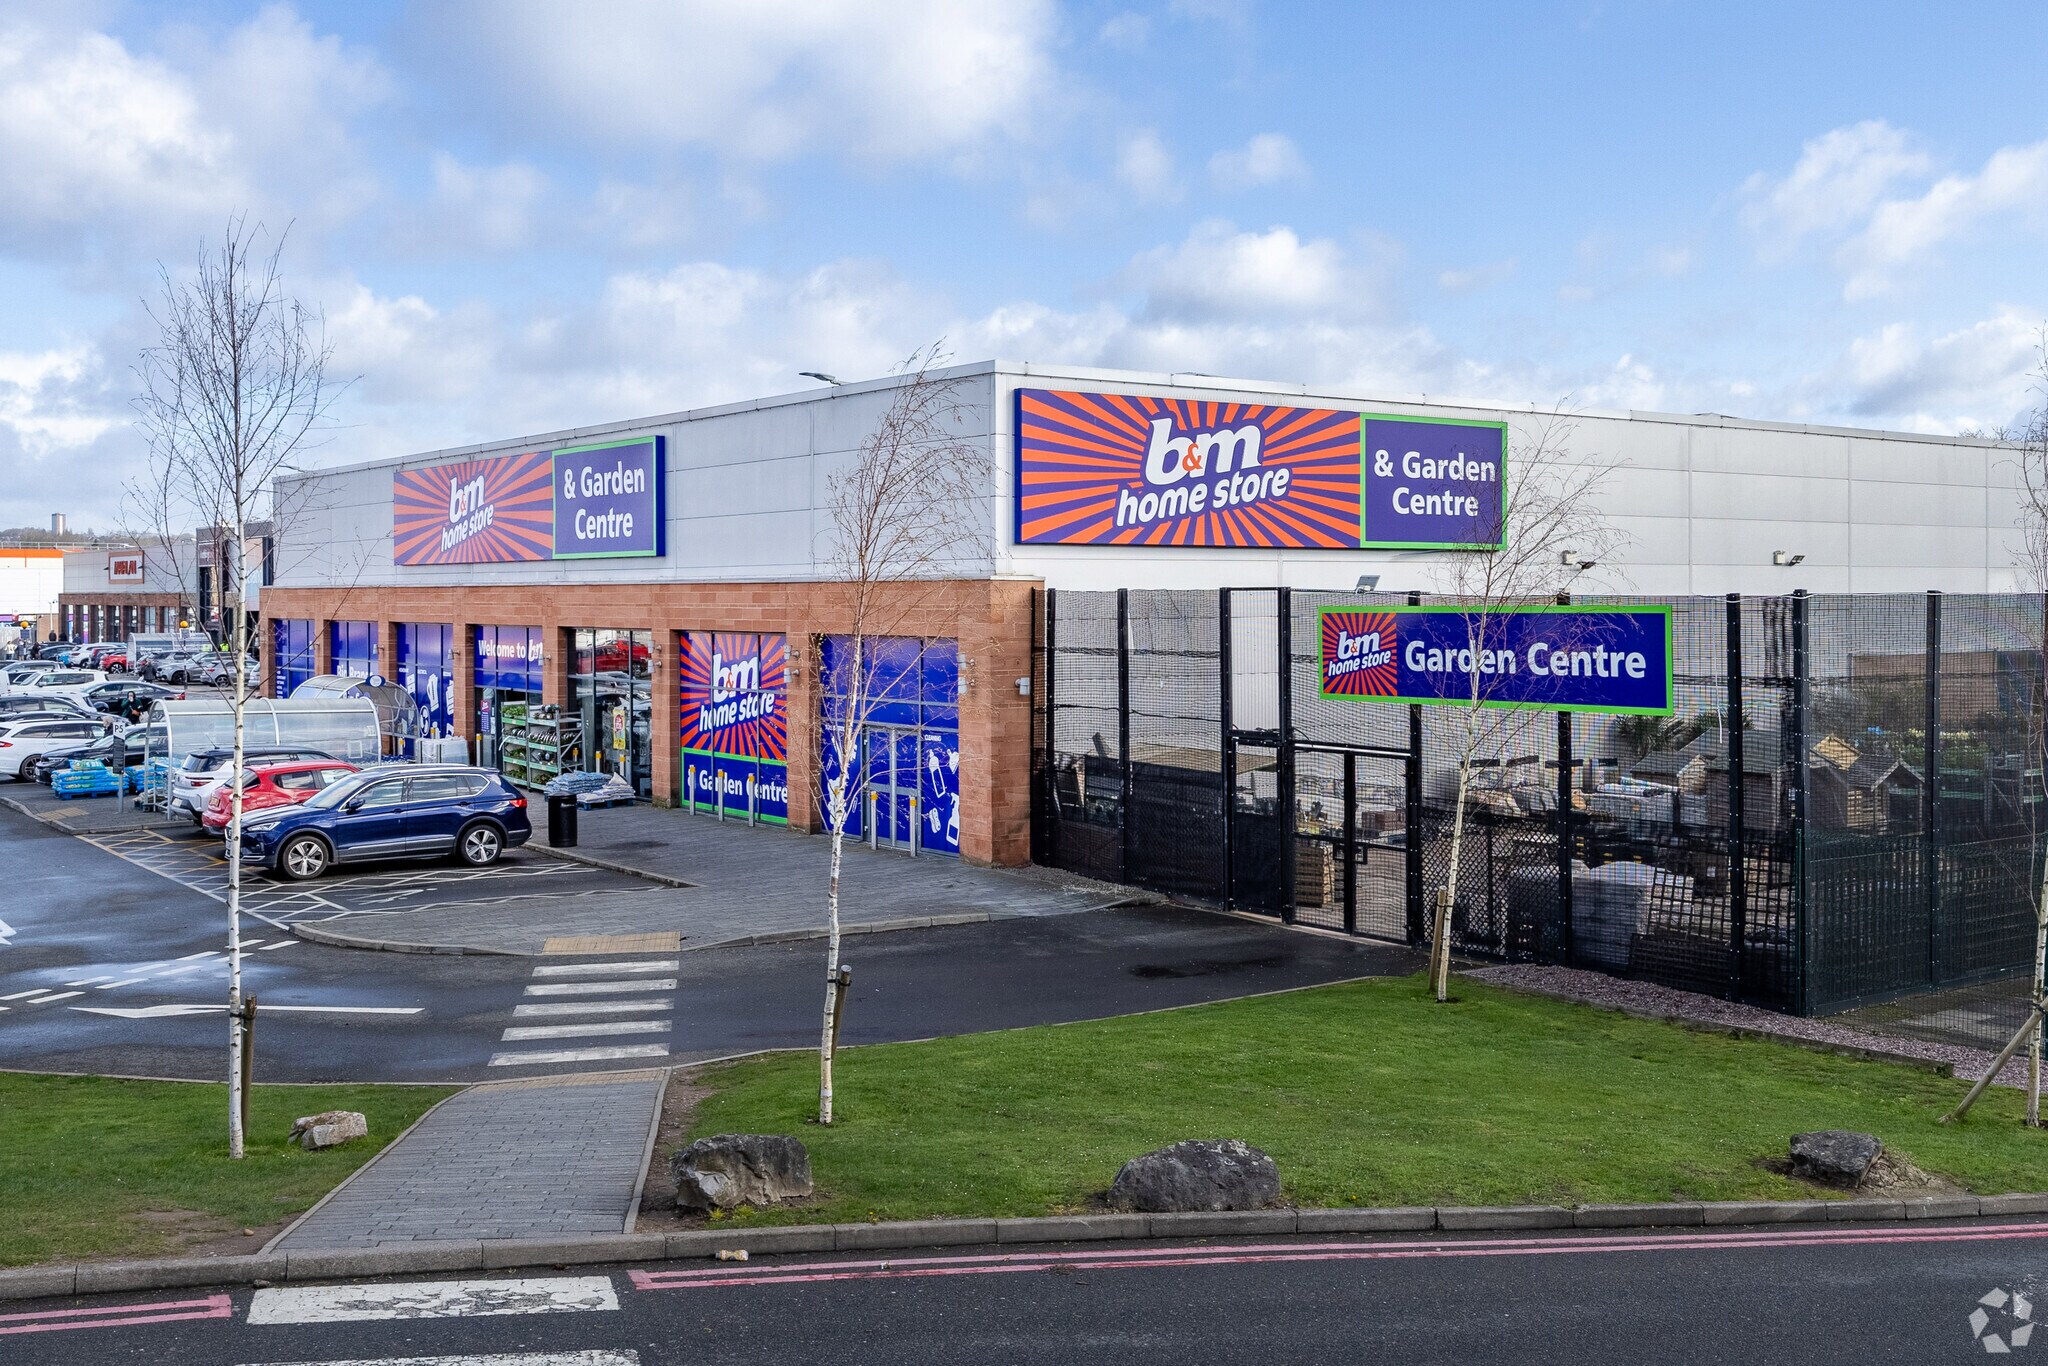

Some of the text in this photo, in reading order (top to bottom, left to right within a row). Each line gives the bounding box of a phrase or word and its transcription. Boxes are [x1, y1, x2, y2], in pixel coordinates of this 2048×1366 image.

[1144, 416, 1262, 486] b&m
[1373, 448, 1497, 483] & Garden
[449, 474, 486, 524] b&m
[563, 460, 646, 500] & Garden
[1115, 467, 1290, 527] home store
[1392, 486, 1479, 517] Centre
[440, 503, 495, 552] home store
[574, 507, 634, 540] Centre
[478, 639, 515, 658] Welcome
[516, 642, 526, 659] to
[1327, 650, 1392, 677] home store
[1337, 630, 1381, 658] b&m
[1404, 639, 1647, 679] Garden Centre
[713, 653, 759, 703] b&m
[699, 692, 775, 732] home store
